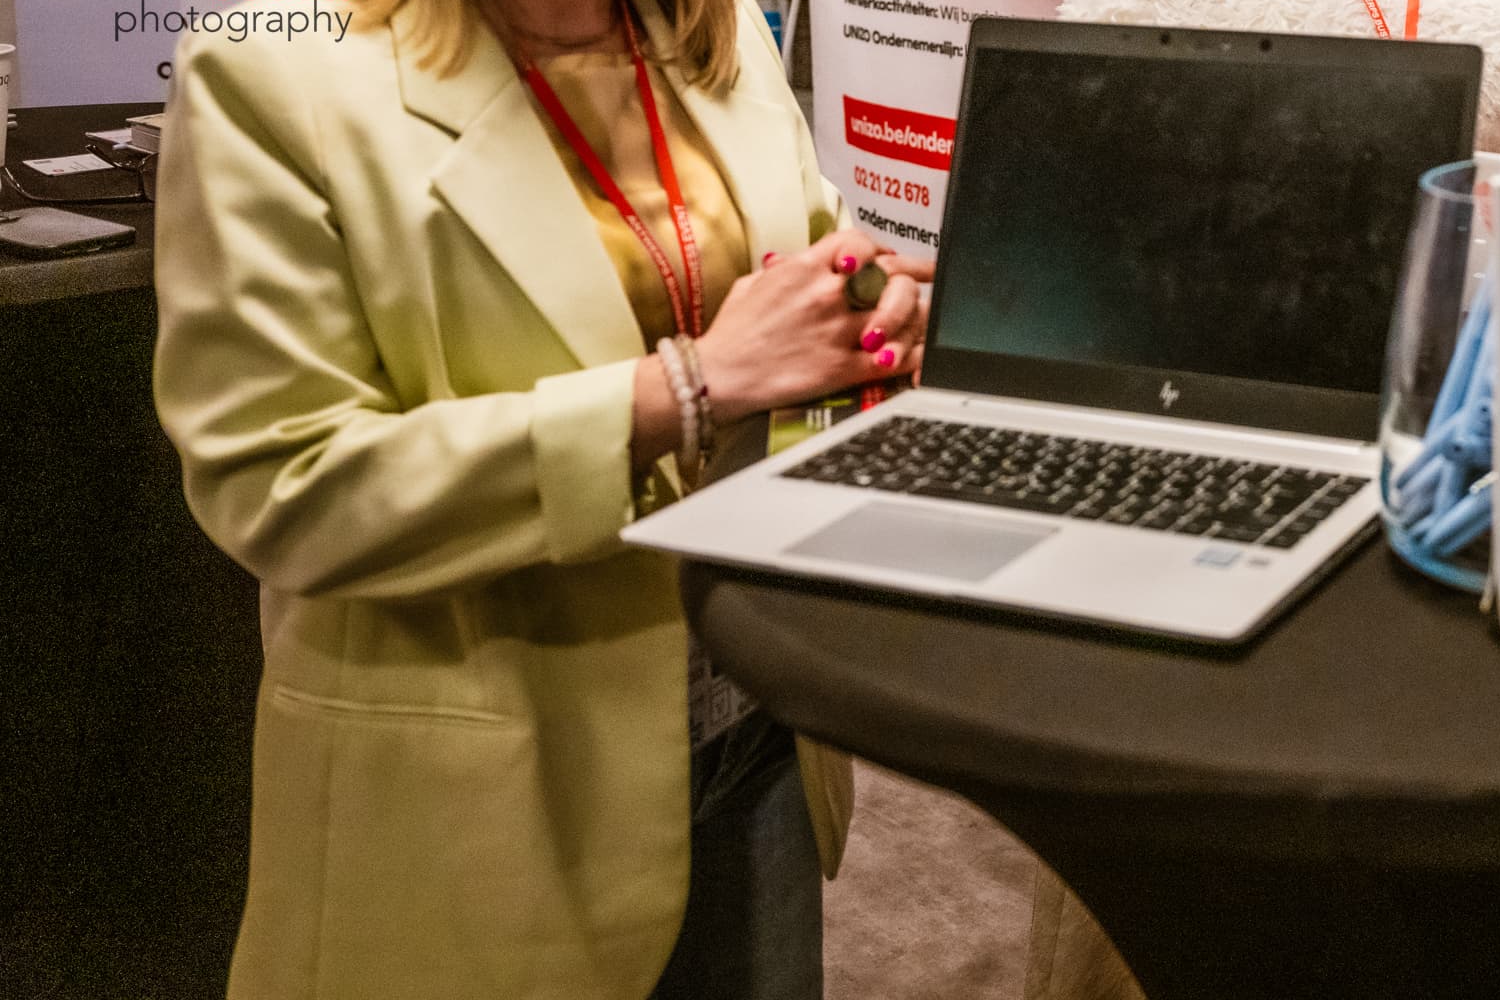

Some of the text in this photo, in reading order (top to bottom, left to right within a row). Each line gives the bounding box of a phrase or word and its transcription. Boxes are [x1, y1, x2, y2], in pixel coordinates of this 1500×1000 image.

[940, 5, 959, 24] Wij
[843, 23, 963, 58] UNIZO Ondernemerslijn:
[854, 165, 930, 208] 02 21 22 678
[857, 204, 939, 248] ondernemers
